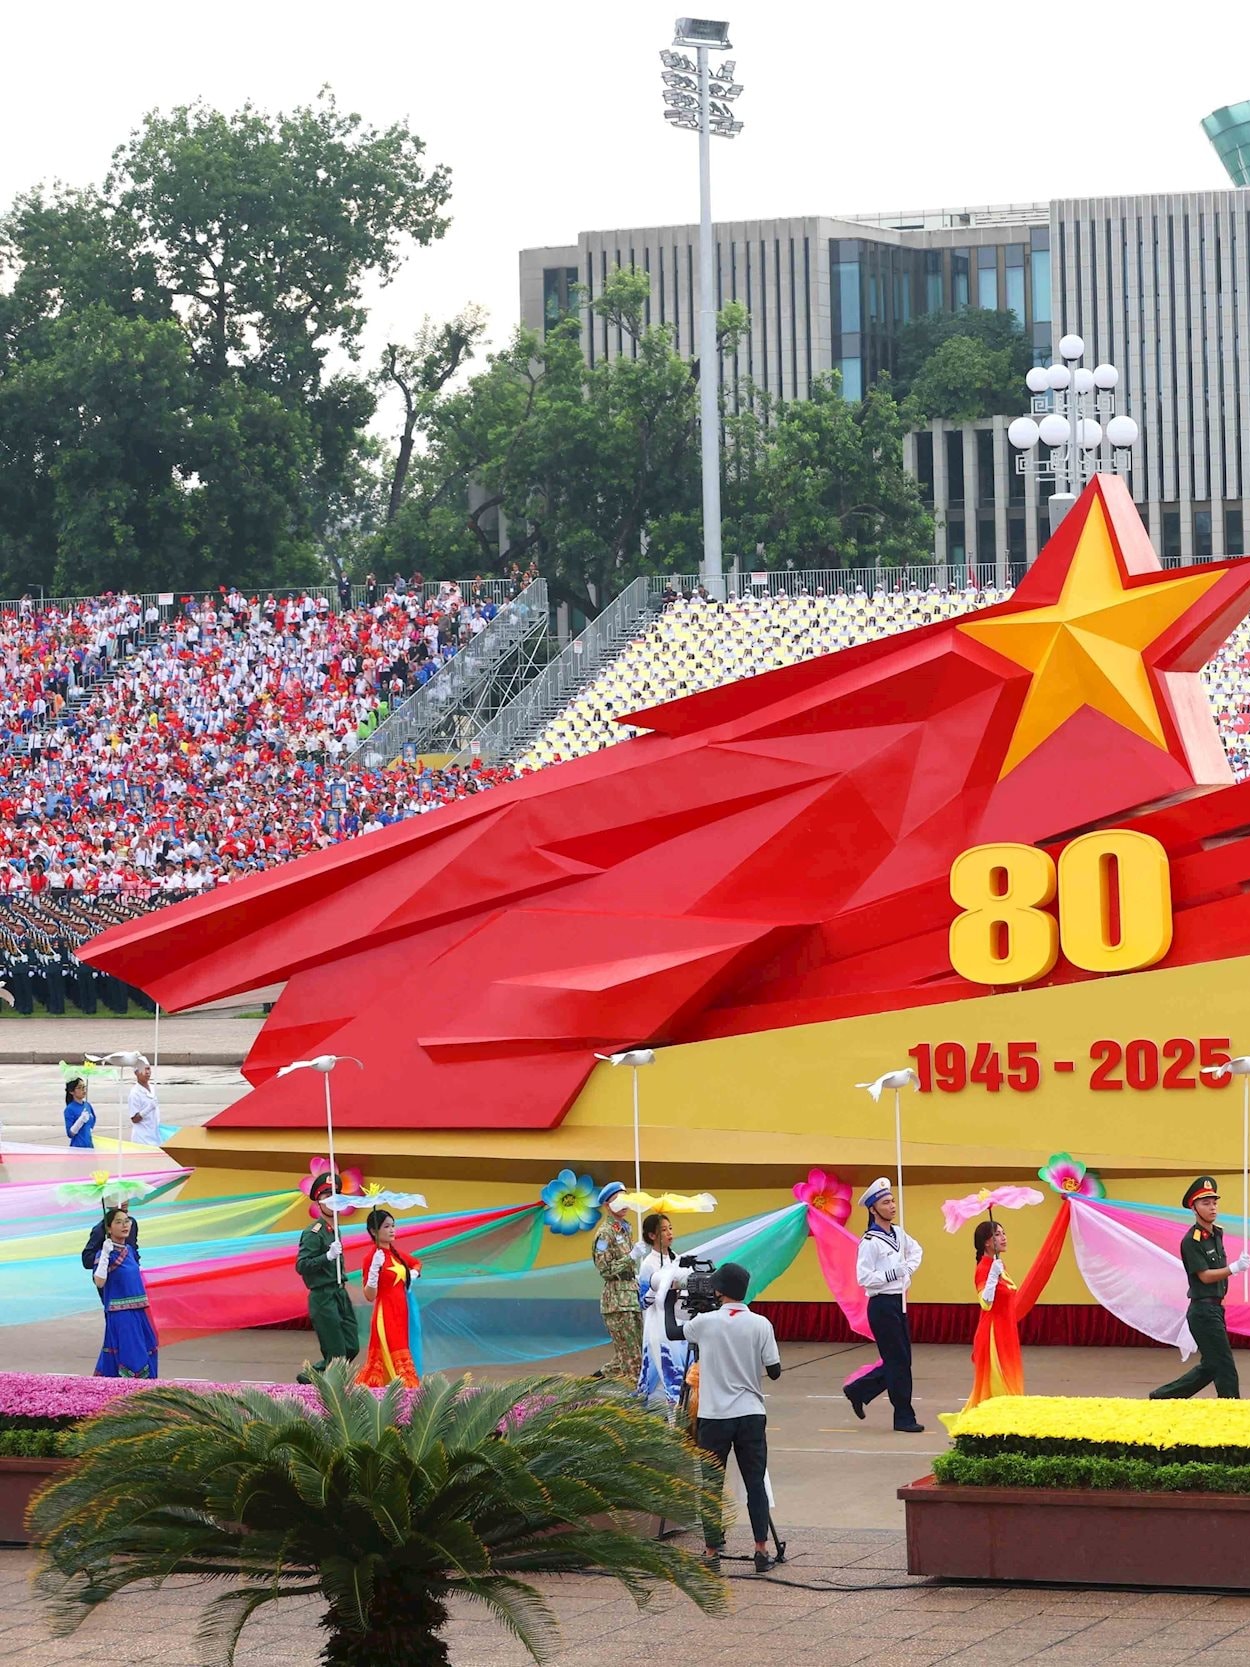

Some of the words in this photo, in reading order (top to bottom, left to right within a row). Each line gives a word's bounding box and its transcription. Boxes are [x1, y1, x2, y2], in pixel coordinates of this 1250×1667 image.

[949, 829, 1173, 985] 80
[908, 1041, 1041, 1093] 1945
[1089, 1038, 1233, 1091] 2025
